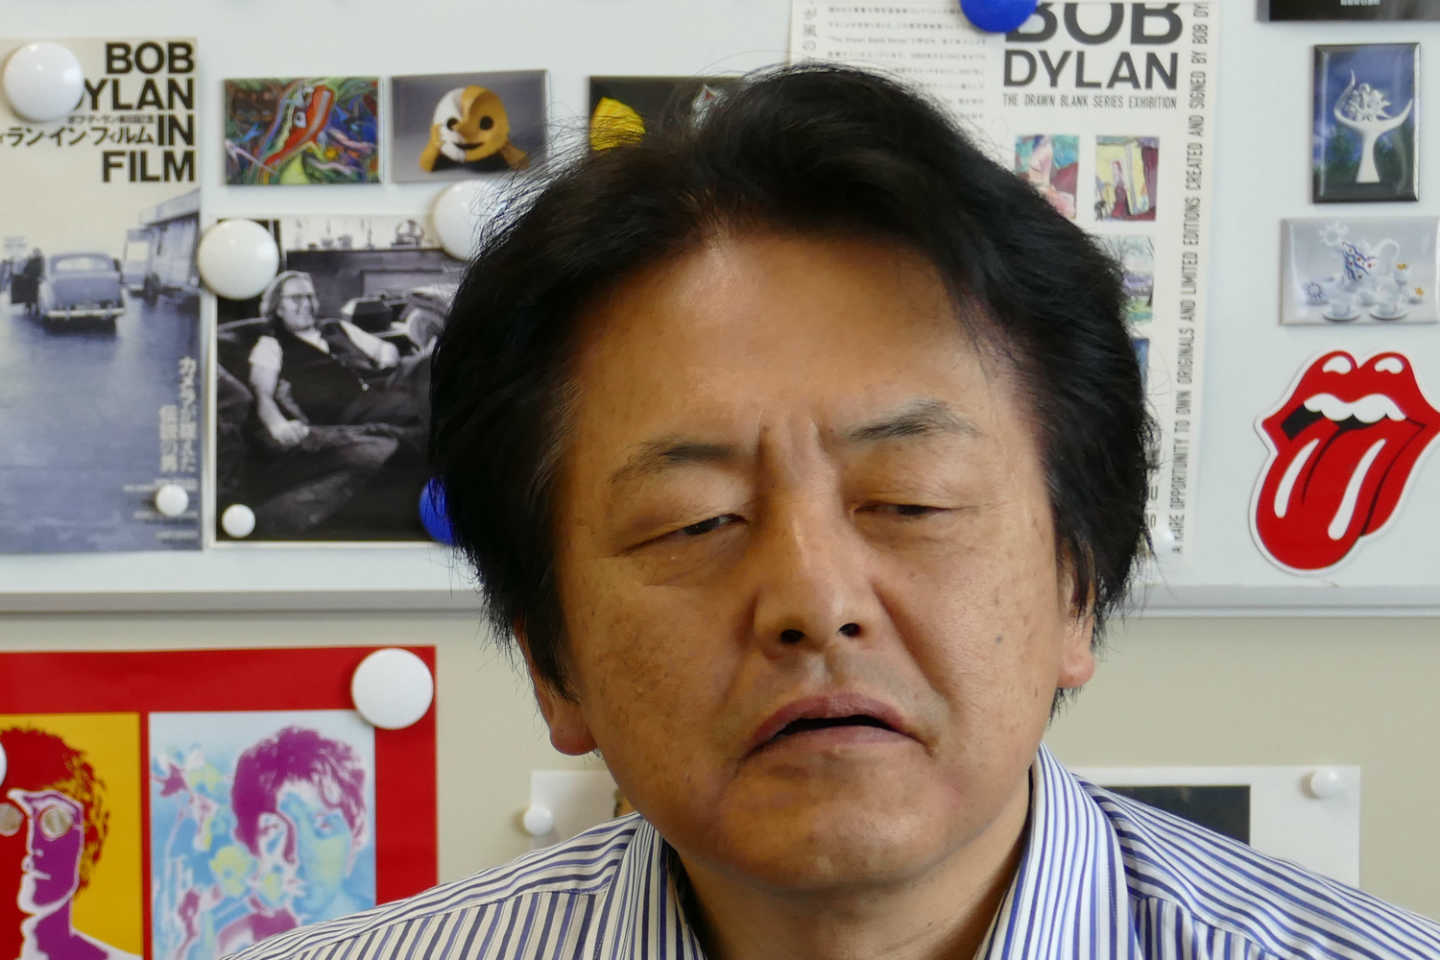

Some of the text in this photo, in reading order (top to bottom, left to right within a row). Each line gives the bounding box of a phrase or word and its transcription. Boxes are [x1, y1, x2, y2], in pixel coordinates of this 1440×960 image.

[1192, 24, 1208, 45] BOB
[106, 42, 194, 74] BOB
[1003, 48, 1178, 90] DYLAN
[1191, 51, 1207, 64] BY
[74, 78, 194, 111] YLAN
[1003, 93, 1177, 110] THE DRAWN BLANK SERIES EXHIBITION
[1189, 71, 1206, 109] SIGNED
[157, 114, 194, 146] IN
[1188, 115, 1205, 137] AND
[102, 150, 195, 183] FILM
[1186, 142, 1203, 191] CREATED
[1183, 197, 1201, 246] EDITIONS
[1180, 252, 1198, 295] LIMITED
[1180, 300, 1197, 322] AND
[1177, 327, 1195, 384] ORIGINALS
[1176, 390, 1192, 414] OWN
[1174, 420, 1190, 433] TO
[1170, 439, 1189, 510] OPPORTUNITY
